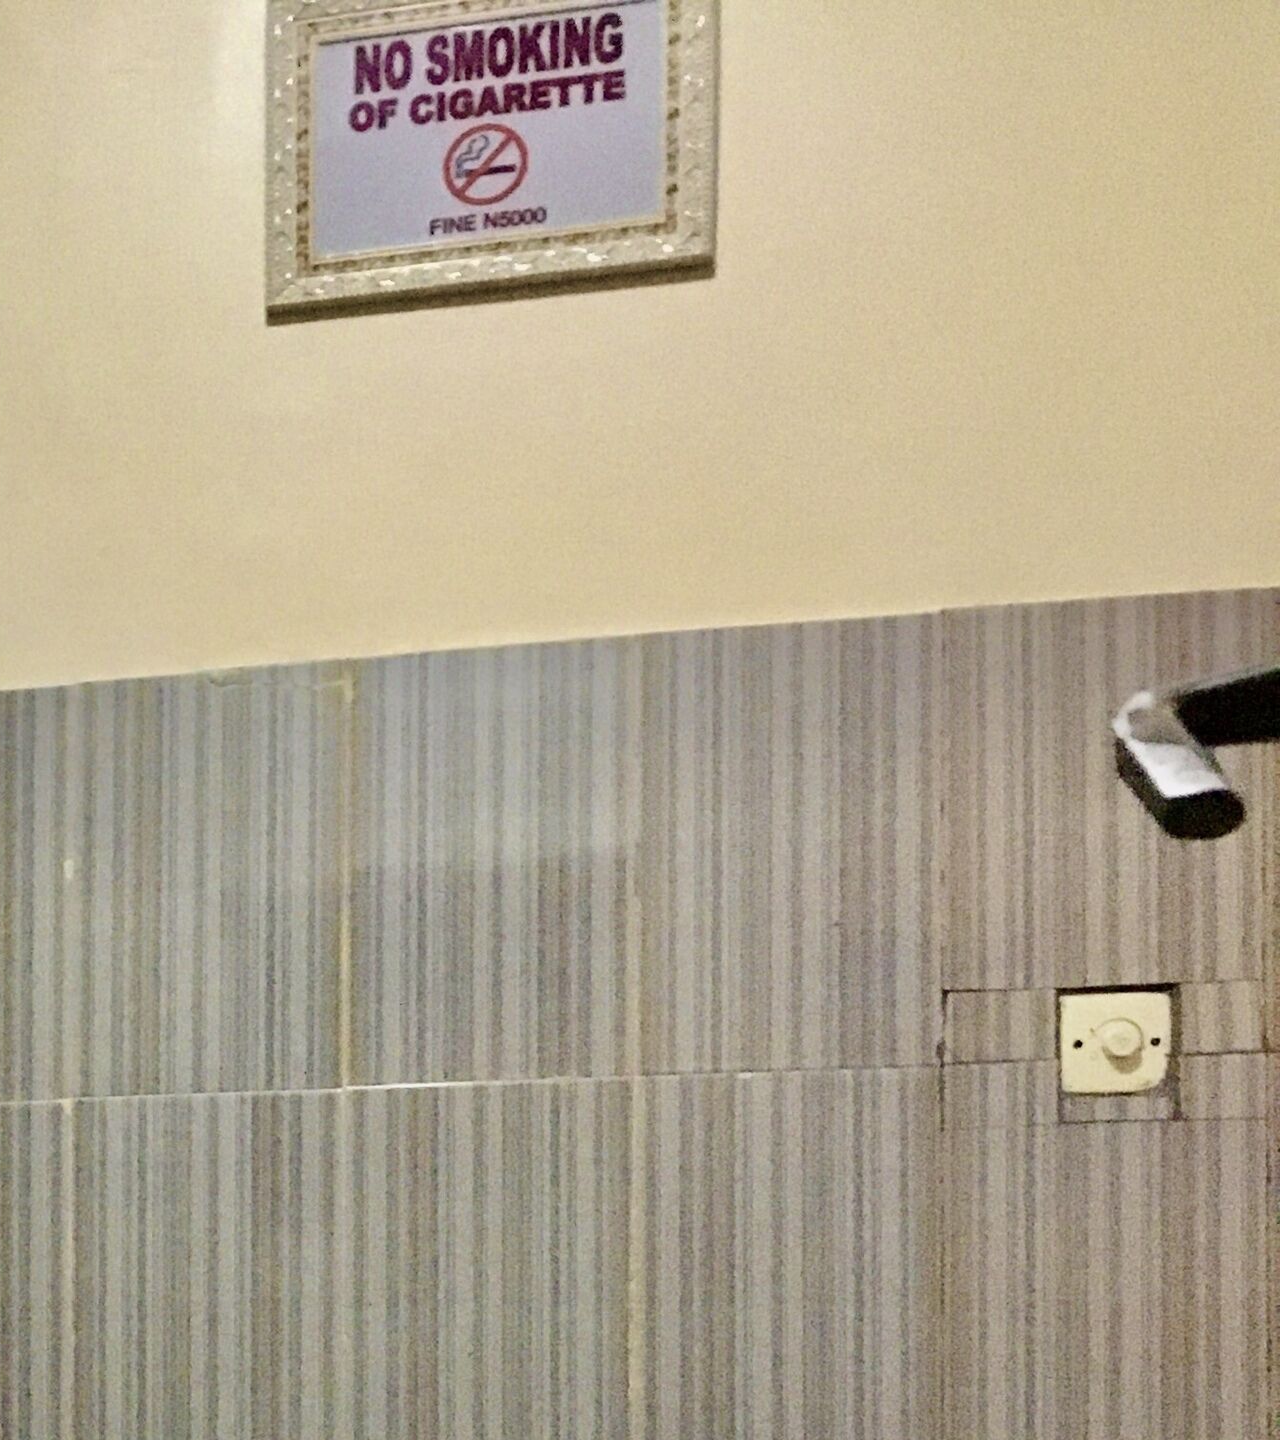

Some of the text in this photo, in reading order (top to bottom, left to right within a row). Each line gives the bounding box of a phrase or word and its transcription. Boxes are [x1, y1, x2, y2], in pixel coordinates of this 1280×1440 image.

[354, 12, 624, 95] NO SMOKING
[348, 69, 626, 132] OF CIGARETTE
[429, 206, 547, 235] FINE N5000
